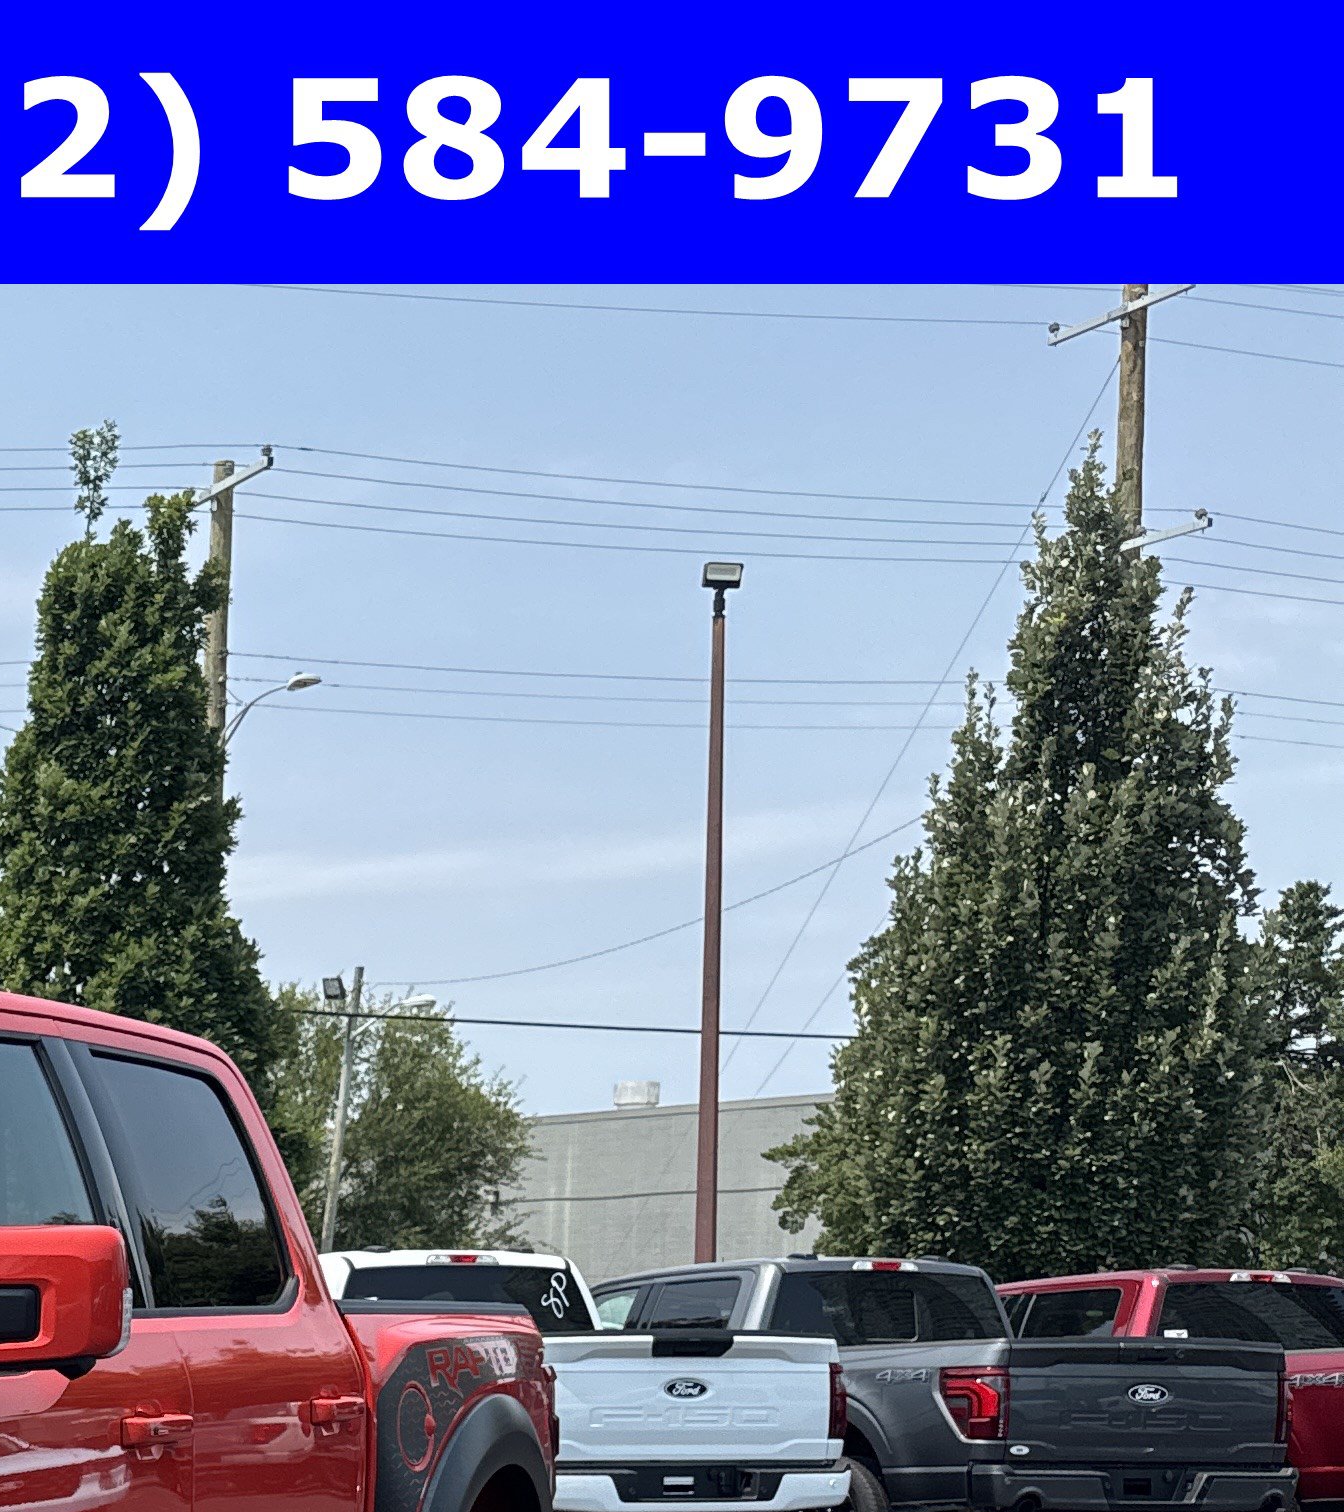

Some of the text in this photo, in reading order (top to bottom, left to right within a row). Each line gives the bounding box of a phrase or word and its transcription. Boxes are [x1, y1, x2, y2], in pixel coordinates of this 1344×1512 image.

[671, 1381, 704, 1397] Ford
[1134, 1386, 1162, 1401] Ford
[589, 1406, 780, 1428] F-150
